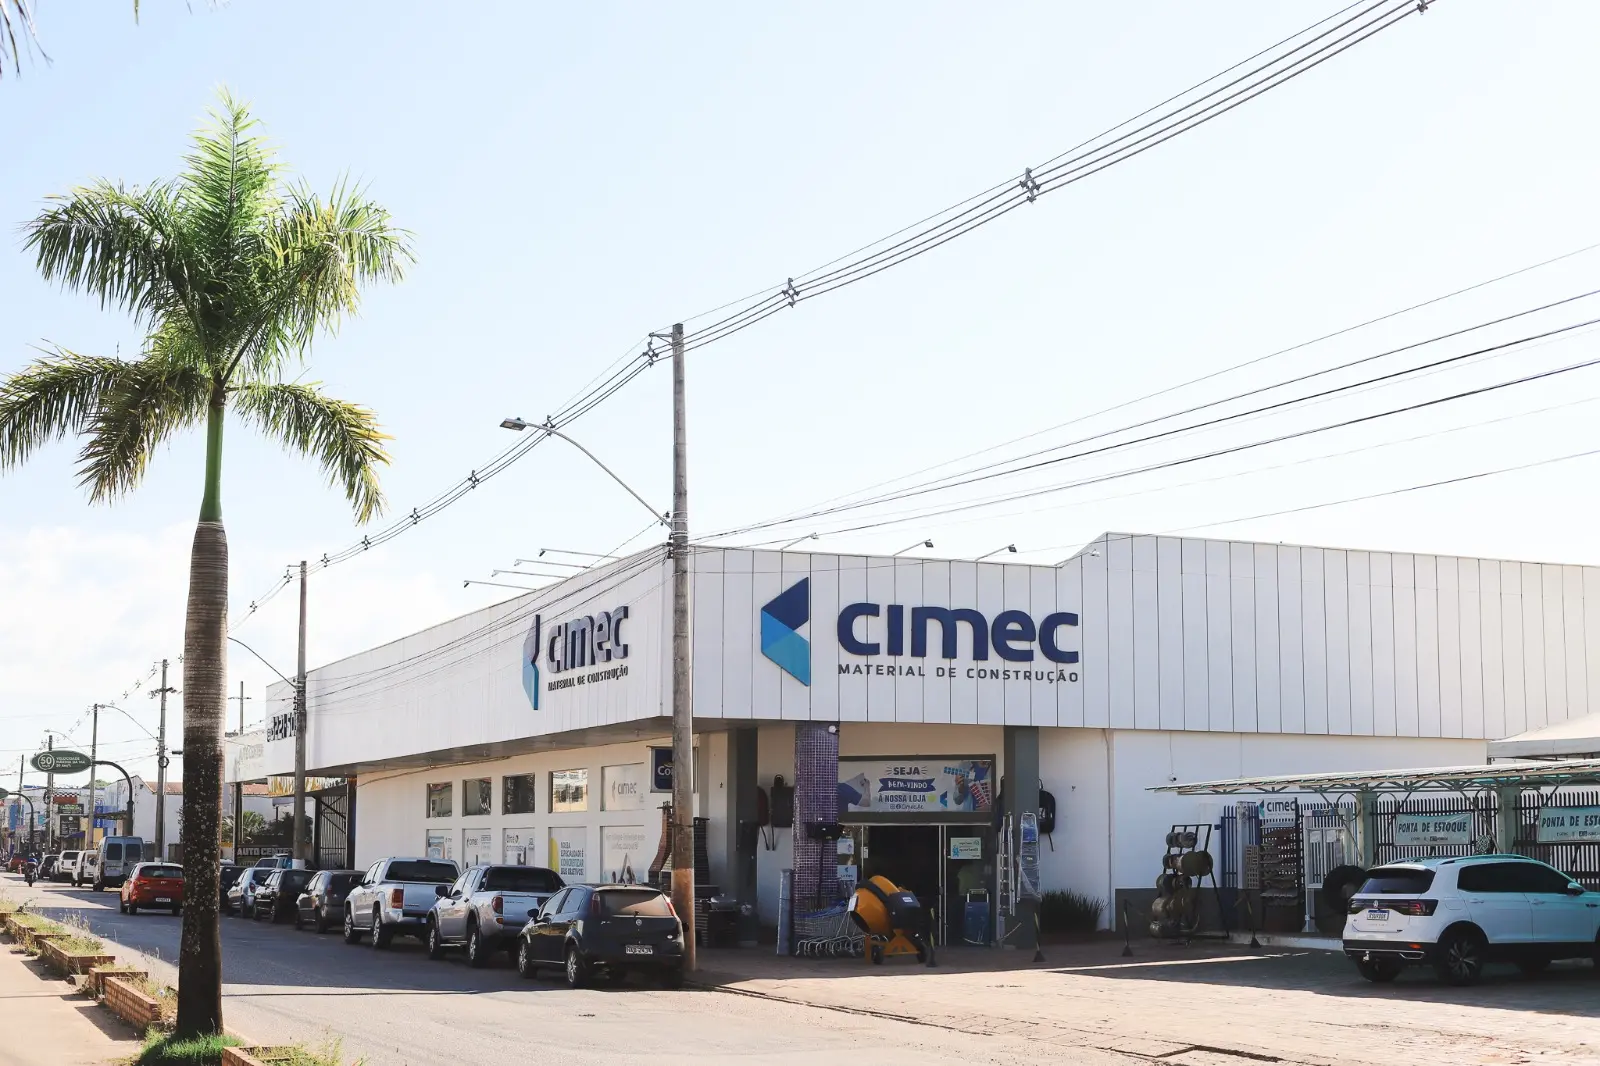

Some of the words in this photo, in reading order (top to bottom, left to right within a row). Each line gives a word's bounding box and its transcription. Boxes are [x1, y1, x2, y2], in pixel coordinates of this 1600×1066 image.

[548, 677, 576, 691] MATERIAL
[577, 675, 586, 686] DE
[587, 664, 629, 684] CONSTRUÇÃO
[838, 664, 926, 677] MATERIAL
[936, 667, 957, 678] DE
[966, 668, 1079, 684] CONSTRUÇÃO
[40, 756, 52, 764] 50
[893, 766, 920, 775] SEJA
[888, 780, 928, 789] BEM-VINDO
[885, 794, 907, 802] NOSSA
[909, 794, 926, 802] LOJA
[1541, 816, 1565, 828] PONTA
[1570, 815, 1580, 826] DE
[1584, 815, 1600, 826] EST
[1398, 822, 1418, 832] PONTA
[1422, 822, 1431, 832] DE
[1434, 821, 1467, 832] ESTOQUE
[237, 847, 260, 856] AUTO
[261, 847, 291, 856] CENTE
